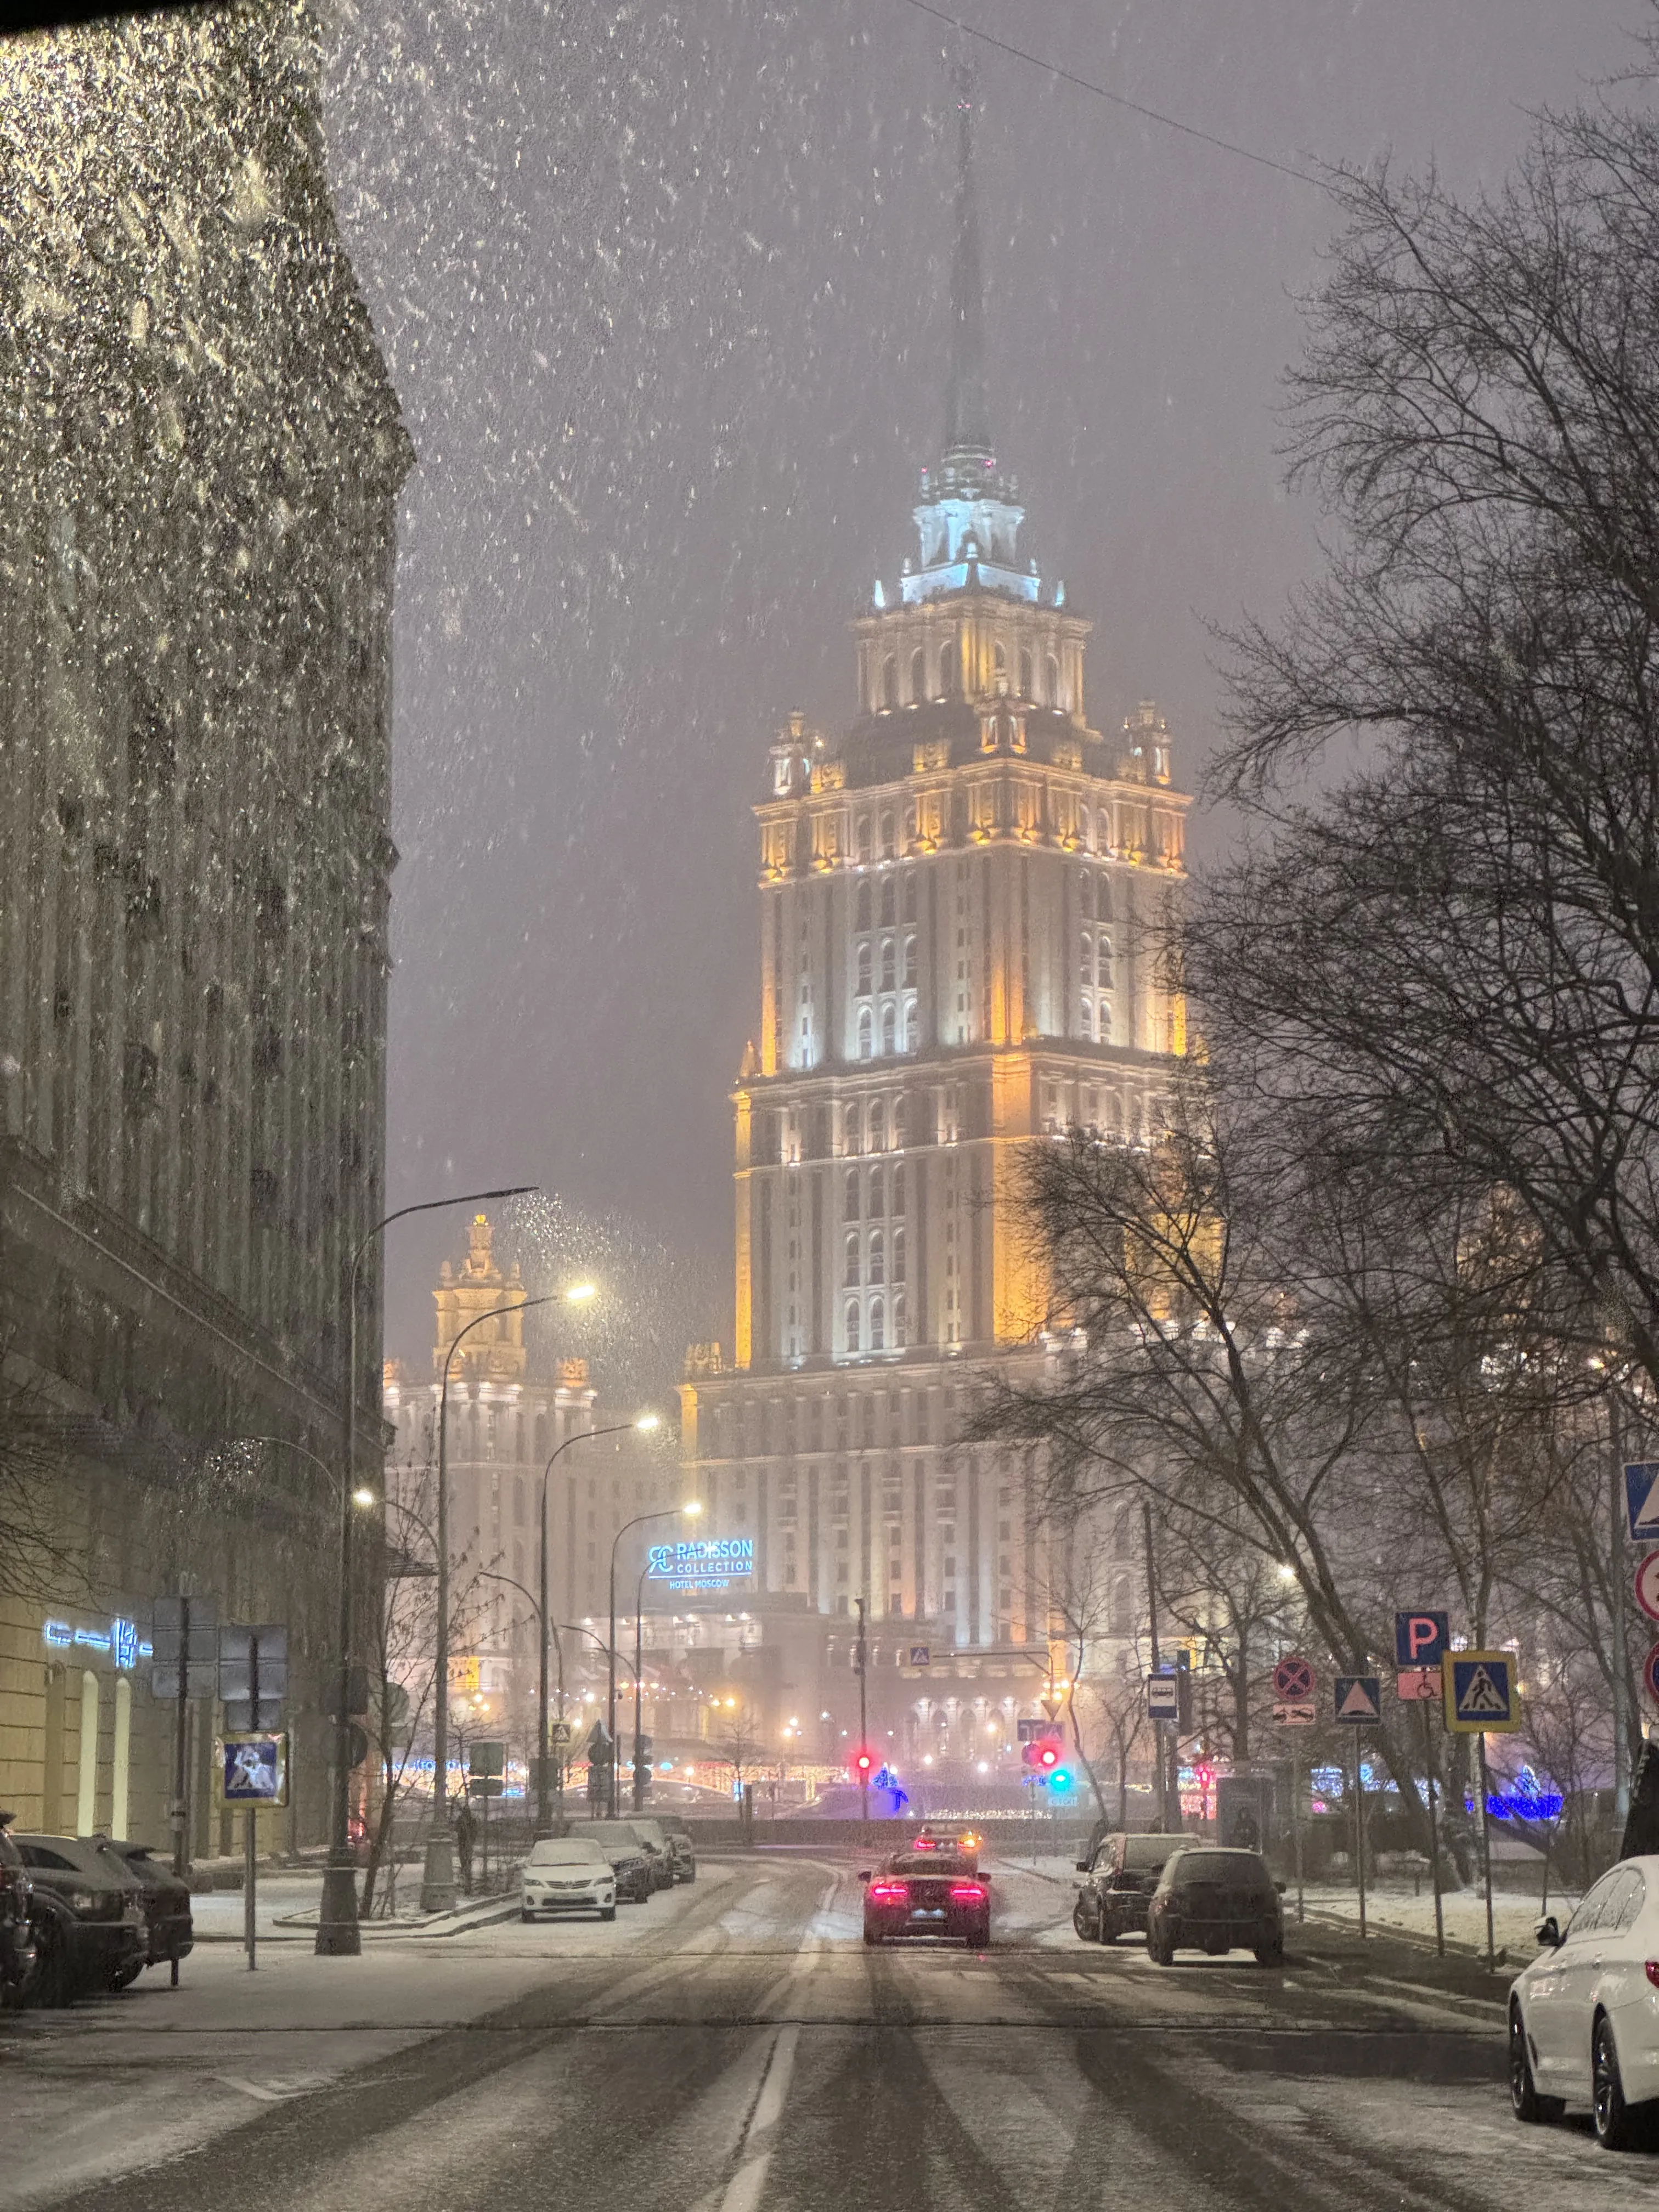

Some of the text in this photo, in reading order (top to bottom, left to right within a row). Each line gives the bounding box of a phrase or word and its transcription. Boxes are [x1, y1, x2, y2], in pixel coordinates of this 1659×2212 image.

[676, 1539, 753, 1560] RADISSON
[676, 1560, 753, 1573] COLLECTION
[669, 1579, 730, 1589] HOTEL MOSCOW
[1408, 1617, 1438, 1660] P
